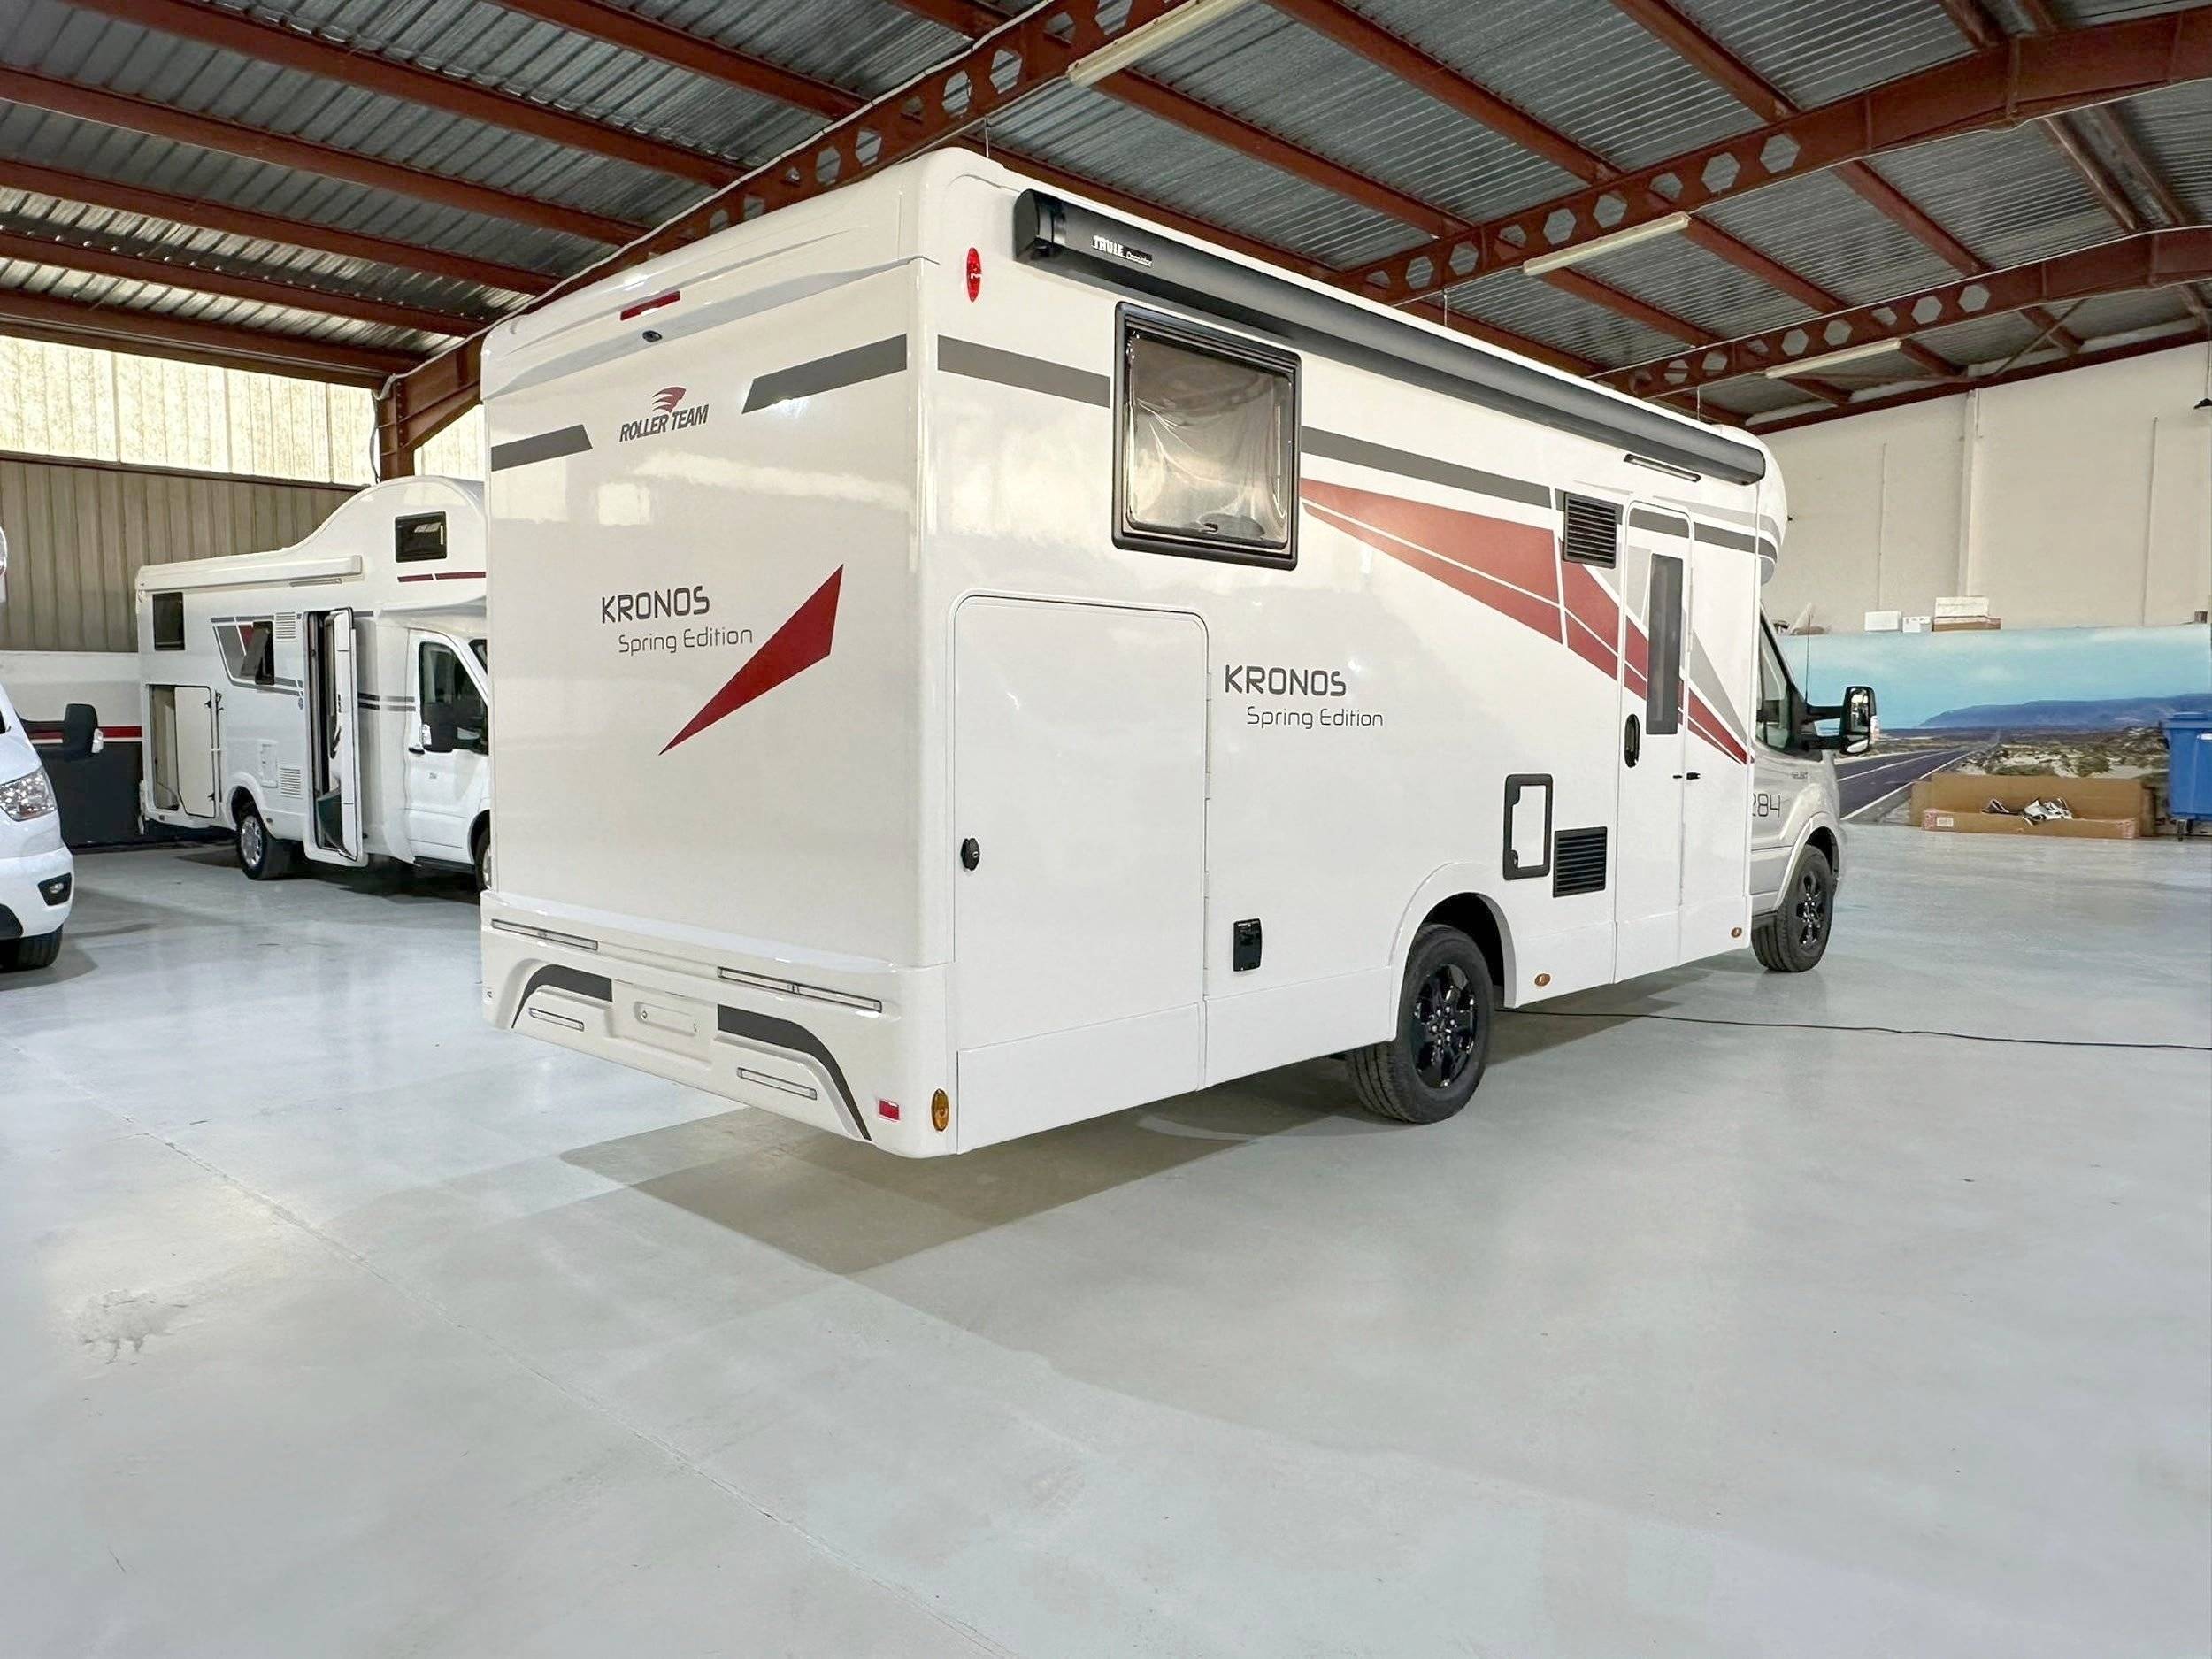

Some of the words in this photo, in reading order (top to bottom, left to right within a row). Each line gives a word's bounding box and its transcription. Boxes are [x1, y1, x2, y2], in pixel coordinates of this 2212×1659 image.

[1092, 234, 1124, 257] THULE
[619, 414, 670, 442] ROLLER
[671, 403, 710, 431] TEAM
[602, 585, 710, 624] KRONOS
[618, 633, 677, 657] Spring
[683, 626, 753, 649] Edition
[1225, 664, 1347, 697] KRONOS
[1247, 705, 1313, 730] Spring
[1320, 708, 1384, 726] Edition
